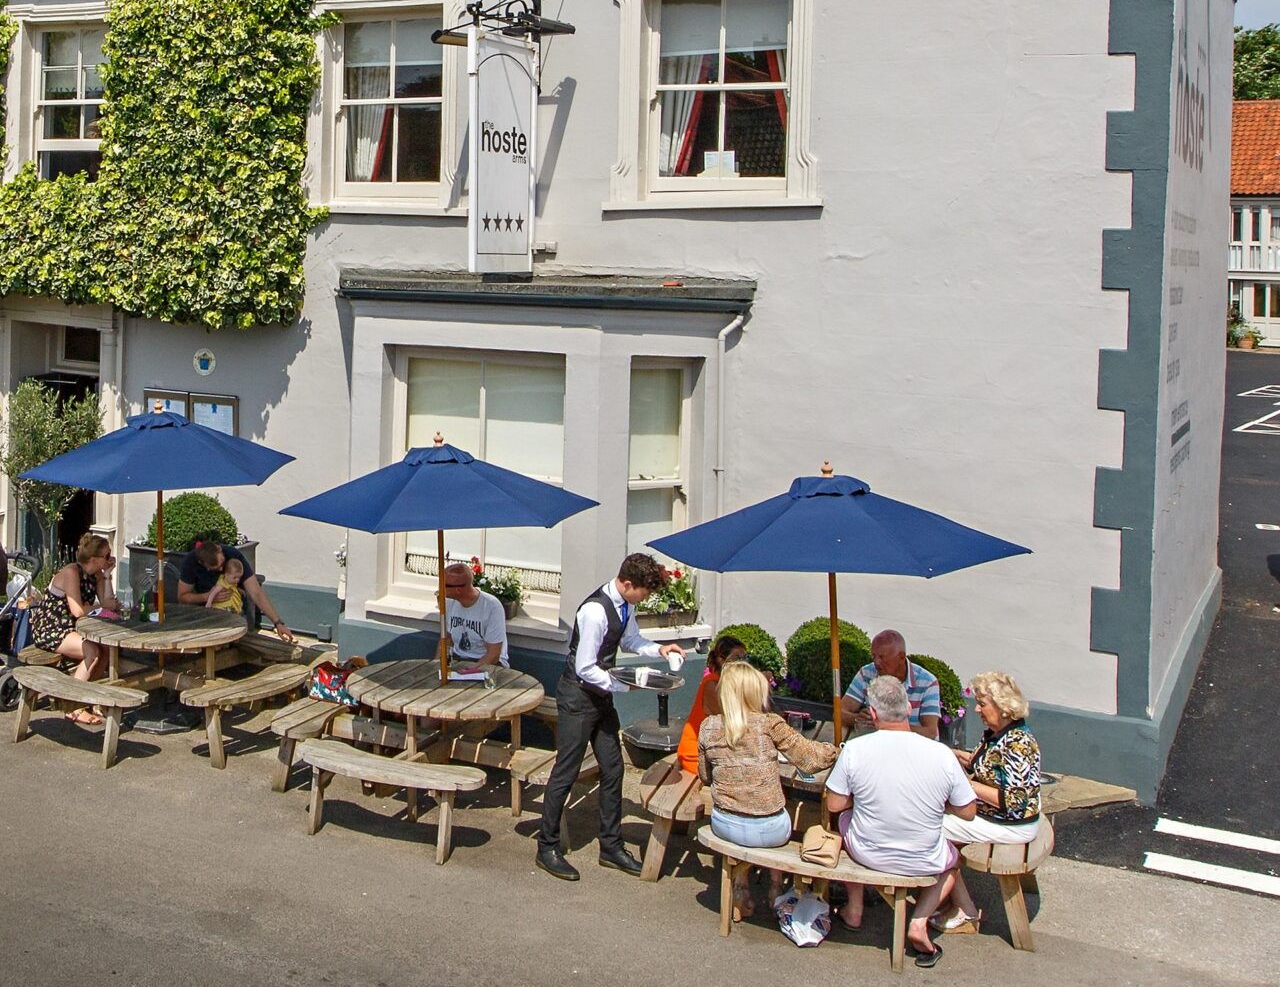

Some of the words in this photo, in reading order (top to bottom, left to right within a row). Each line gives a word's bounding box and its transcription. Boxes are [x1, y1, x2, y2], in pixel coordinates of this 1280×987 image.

[1175, 29, 1205, 173] hoste
[484, 119, 494, 130] the
[481, 121, 527, 155] hoste
[512, 154, 527, 164] arms
